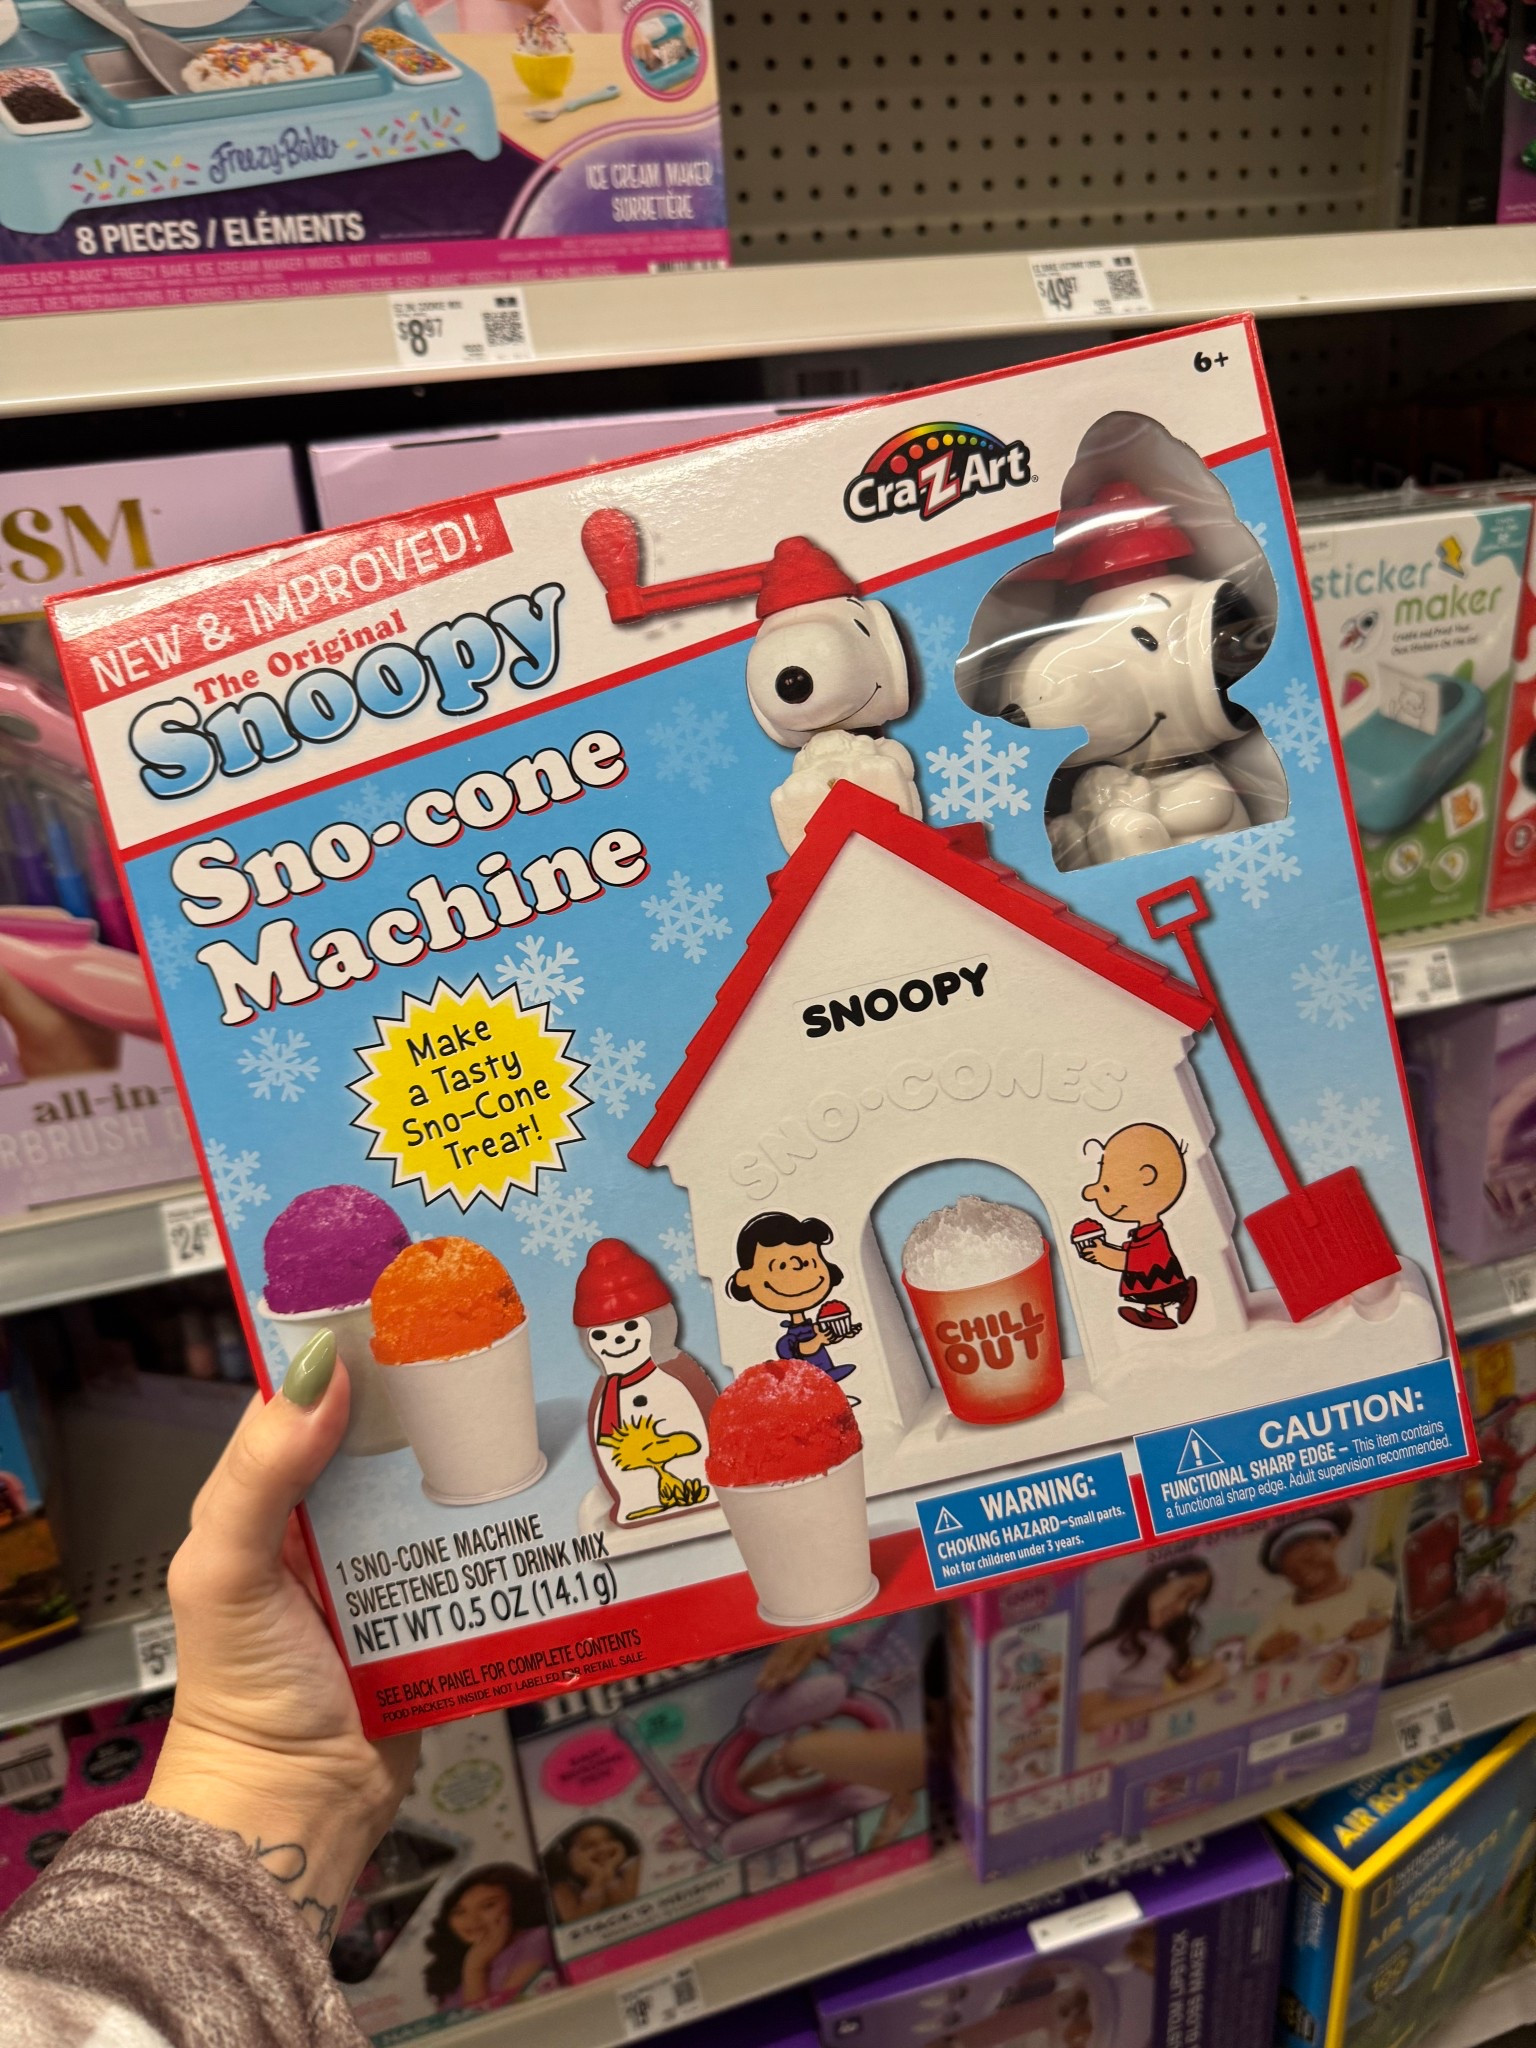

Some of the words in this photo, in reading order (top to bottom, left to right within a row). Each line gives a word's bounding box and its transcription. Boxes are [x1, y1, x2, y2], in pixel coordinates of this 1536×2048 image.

[75, 226, 98, 255] 8
[100, 219, 201, 253] PIECES
[1192, 350, 1230, 374] 6+
[0, 499, 155, 584] SM
[90, 623, 182, 692] NEW
[196, 611, 235, 652] &
[242, 513, 483, 637] IMPROVED!
[1311, 558, 1432, 602] sticker
[1394, 584, 1502, 626] maker
[127, 581, 565, 800] Snoopy
[194, 669, 260, 704] The
[267, 609, 408, 678] Original
[170, 730, 630, 928] Sno-cone
[196, 828, 649, 1027] Machine
[801, 962, 989, 1039] SNOOPY
[405, 1018, 493, 1067] Make
[408, 1083, 430, 1107] a
[431, 1048, 524, 1096] Tasty
[402, 1079, 552, 1148] Sno-Cone
[444, 1113, 544, 1171] Treat!
[936, 1302, 1045, 1345] CHILL
[945, 1323, 1044, 1375] OUT
[1259, 1386, 1424, 1449] CAUTION:
[1161, 1464, 1248, 1502] FUNCTIONAL
[1250, 1451, 1296, 1480] SHARP
[1299, 1441, 1337, 1468] EDGE
[1352, 1437, 1375, 1455] This
[1376, 1432, 1399, 1449] item
[1401, 1420, 1444, 1442] contains
[1166, 1507, 1174, 1519] a
[1174, 1492, 1225, 1517] functional
[1226, 1485, 1256, 1505] sharp
[1258, 1477, 1287, 1496] edge.
[1289, 1469, 1317, 1488] Adult
[1318, 1454, 1375, 1482] supervision
[1376, 1434, 1453, 1467] recommended.
[979, 1471, 1098, 1522] WARNING:
[336, 1560, 348, 1586] 1
[350, 1536, 451, 1583] SNO-CONE
[453, 1513, 544, 1559] MACHINE
[937, 1529, 1001, 1560] CHOKING
[1097, 1504, 1126, 1525] parts.
[942, 1564, 959, 1578] Not
[961, 1560, 976, 1573] for
[977, 1549, 1017, 1569] children
[1017, 1543, 1045, 1559] under
[1046, 1540, 1054, 1552] 3
[1054, 1534, 1085, 1553] years.
[345, 1567, 460, 1618] SWEETENED
[461, 1555, 509, 1590] SOFT
[512, 1540, 571, 1578] DRINK
[572, 1530, 610, 1563] MIX
[352, 1614, 401, 1656] NET
[403, 1603, 444, 1643] WT
[449, 1595, 487, 1632] 0.5
[490, 1584, 530, 1622] OZ
[532, 1570, 589, 1617] (14.1
[592, 1562, 618, 1606] g)
[375, 1685, 401, 1708] SEE
[402, 1678, 439, 1702] BACK
[438, 1668, 479, 1694] PANEL
[479, 1660, 507, 1683] FOR
[507, 1644, 575, 1676] COMPLETE
[574, 1628, 642, 1660] CONTENTS
[382, 1707, 410, 1723] FOOD
[410, 1697, 455, 1718] PACKETS
[457, 1688, 491, 1706] INSIDE
[491, 1684, 513, 1698] NOT
[515, 1672, 560, 1692] LABELED
[583, 1659, 617, 1676] RETAIL
[619, 1651, 648, 1667] SALE.
